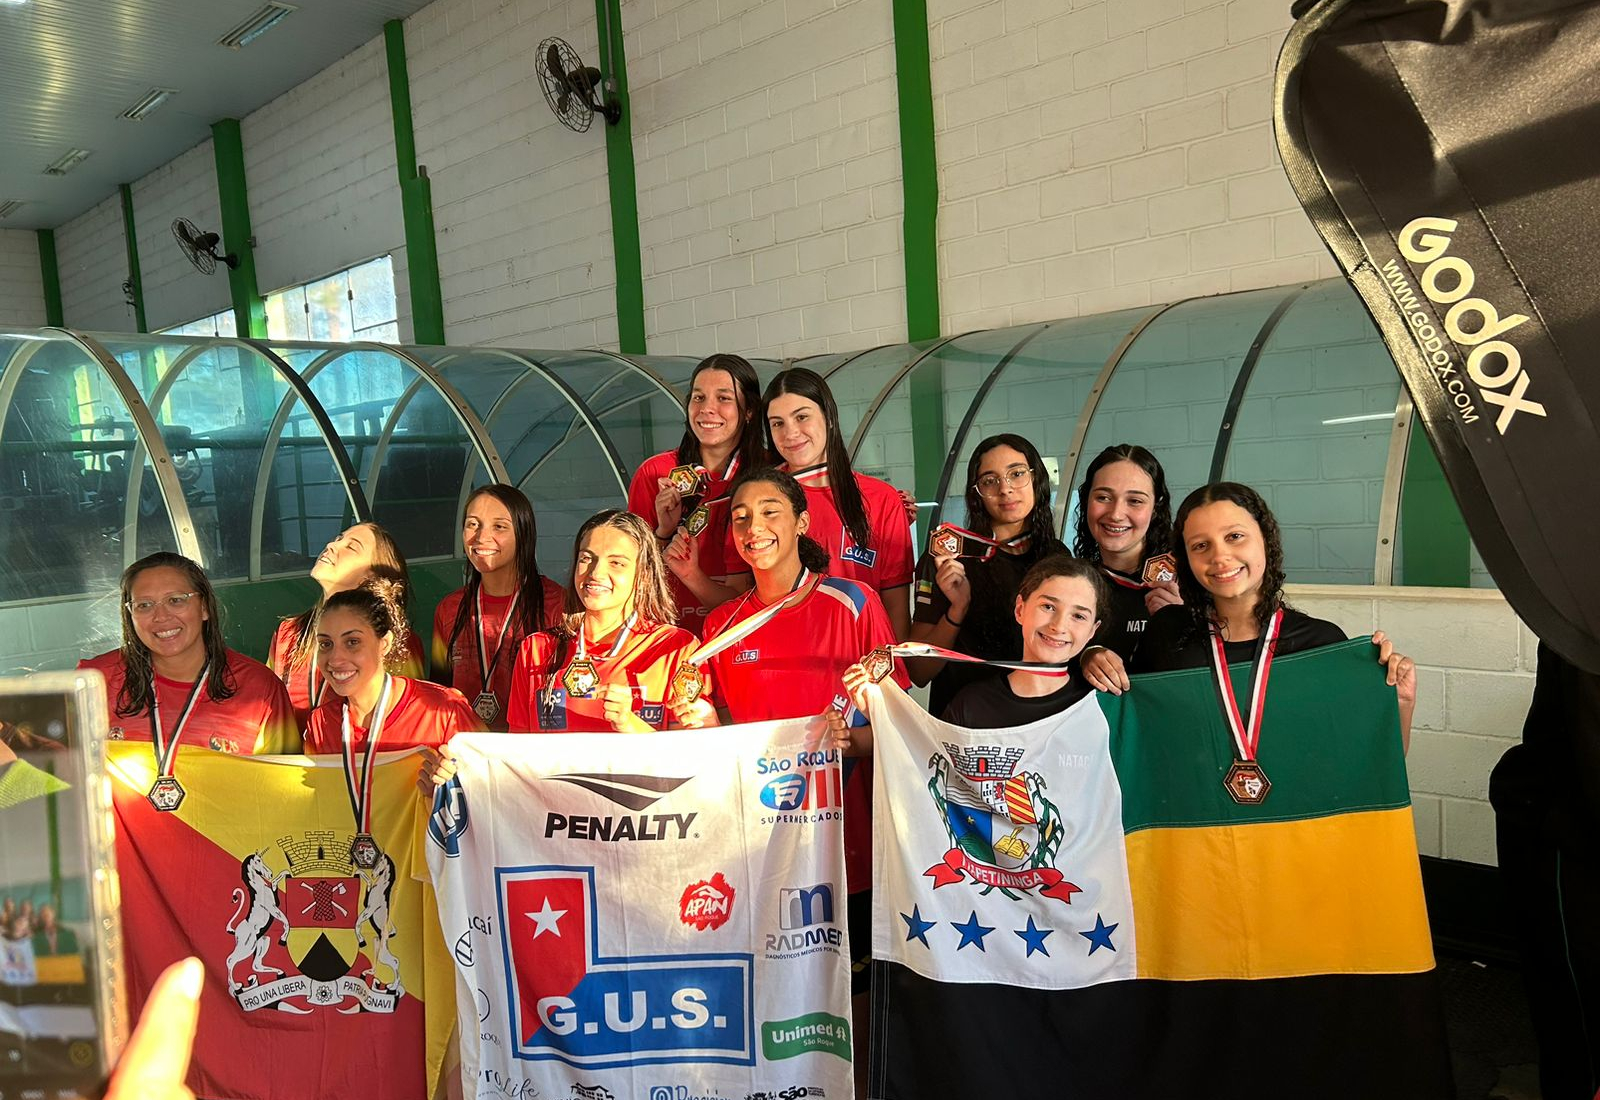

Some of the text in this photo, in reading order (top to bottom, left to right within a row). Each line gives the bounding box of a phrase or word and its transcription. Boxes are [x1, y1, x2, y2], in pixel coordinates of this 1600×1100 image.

[1382, 259, 1480, 424] WWW.GODOX.COM
[1126, 620, 1148, 632] NAT
[757, 758, 791, 775] SÃO
[545, 812, 698, 842] PENALTY
[684, 896, 728, 917] APAN
[765, 927, 842, 951] RADMED
[244, 995, 260, 1008] PRO
[260, 986, 278, 1002] UNA
[278, 980, 307, 996] LIBERA
[536, 987, 728, 1036] G.U.S.
[772, 1023, 834, 1044] Unimed
[803, 1037, 834, 1047] São Roque
